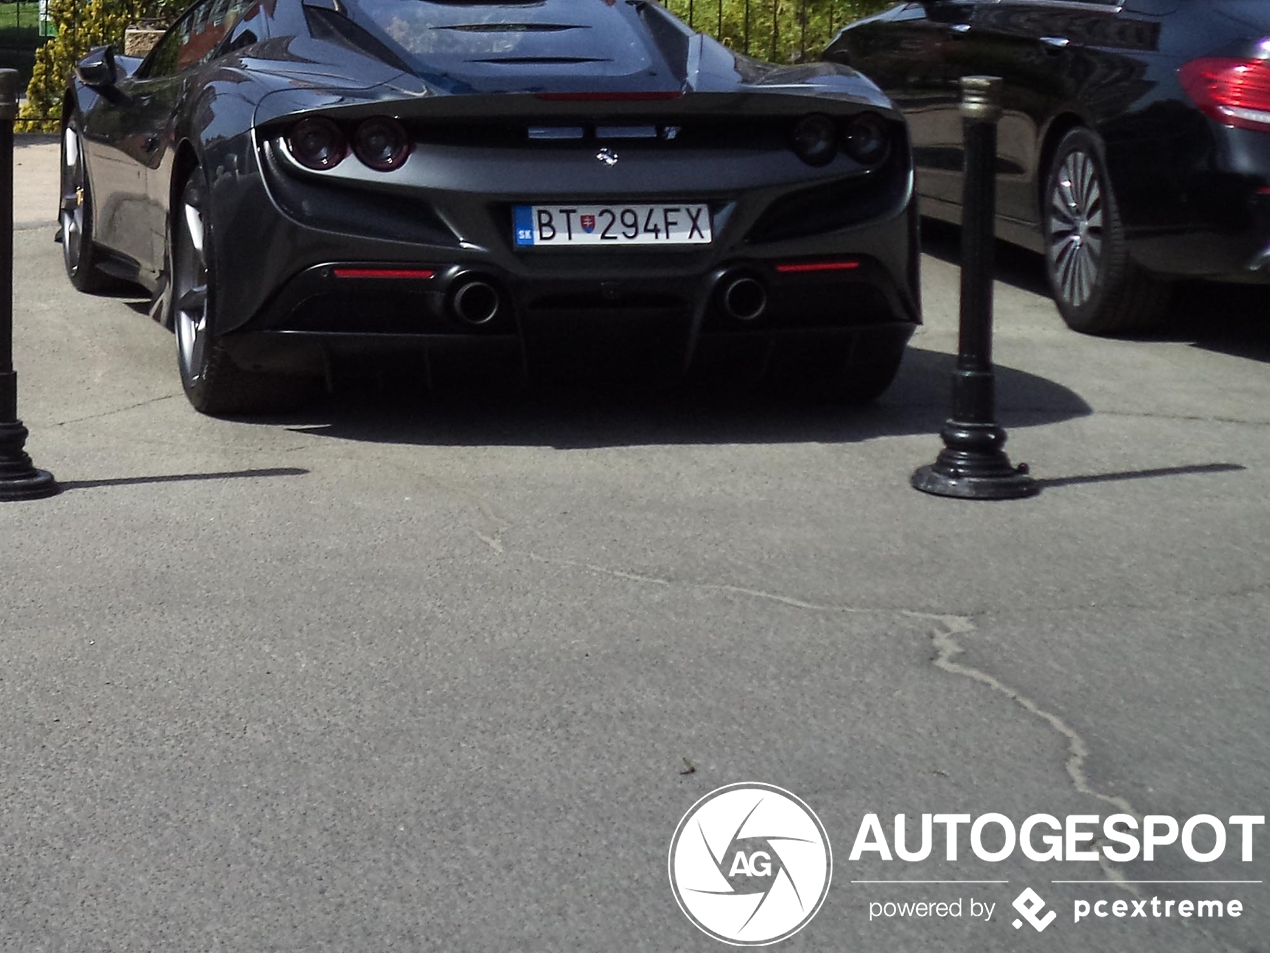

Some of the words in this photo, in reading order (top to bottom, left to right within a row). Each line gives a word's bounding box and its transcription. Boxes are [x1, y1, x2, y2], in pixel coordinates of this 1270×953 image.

[536, 209, 577, 240] BT
[598, 207, 704, 240] 294FX
[518, 230, 532, 239] SK
